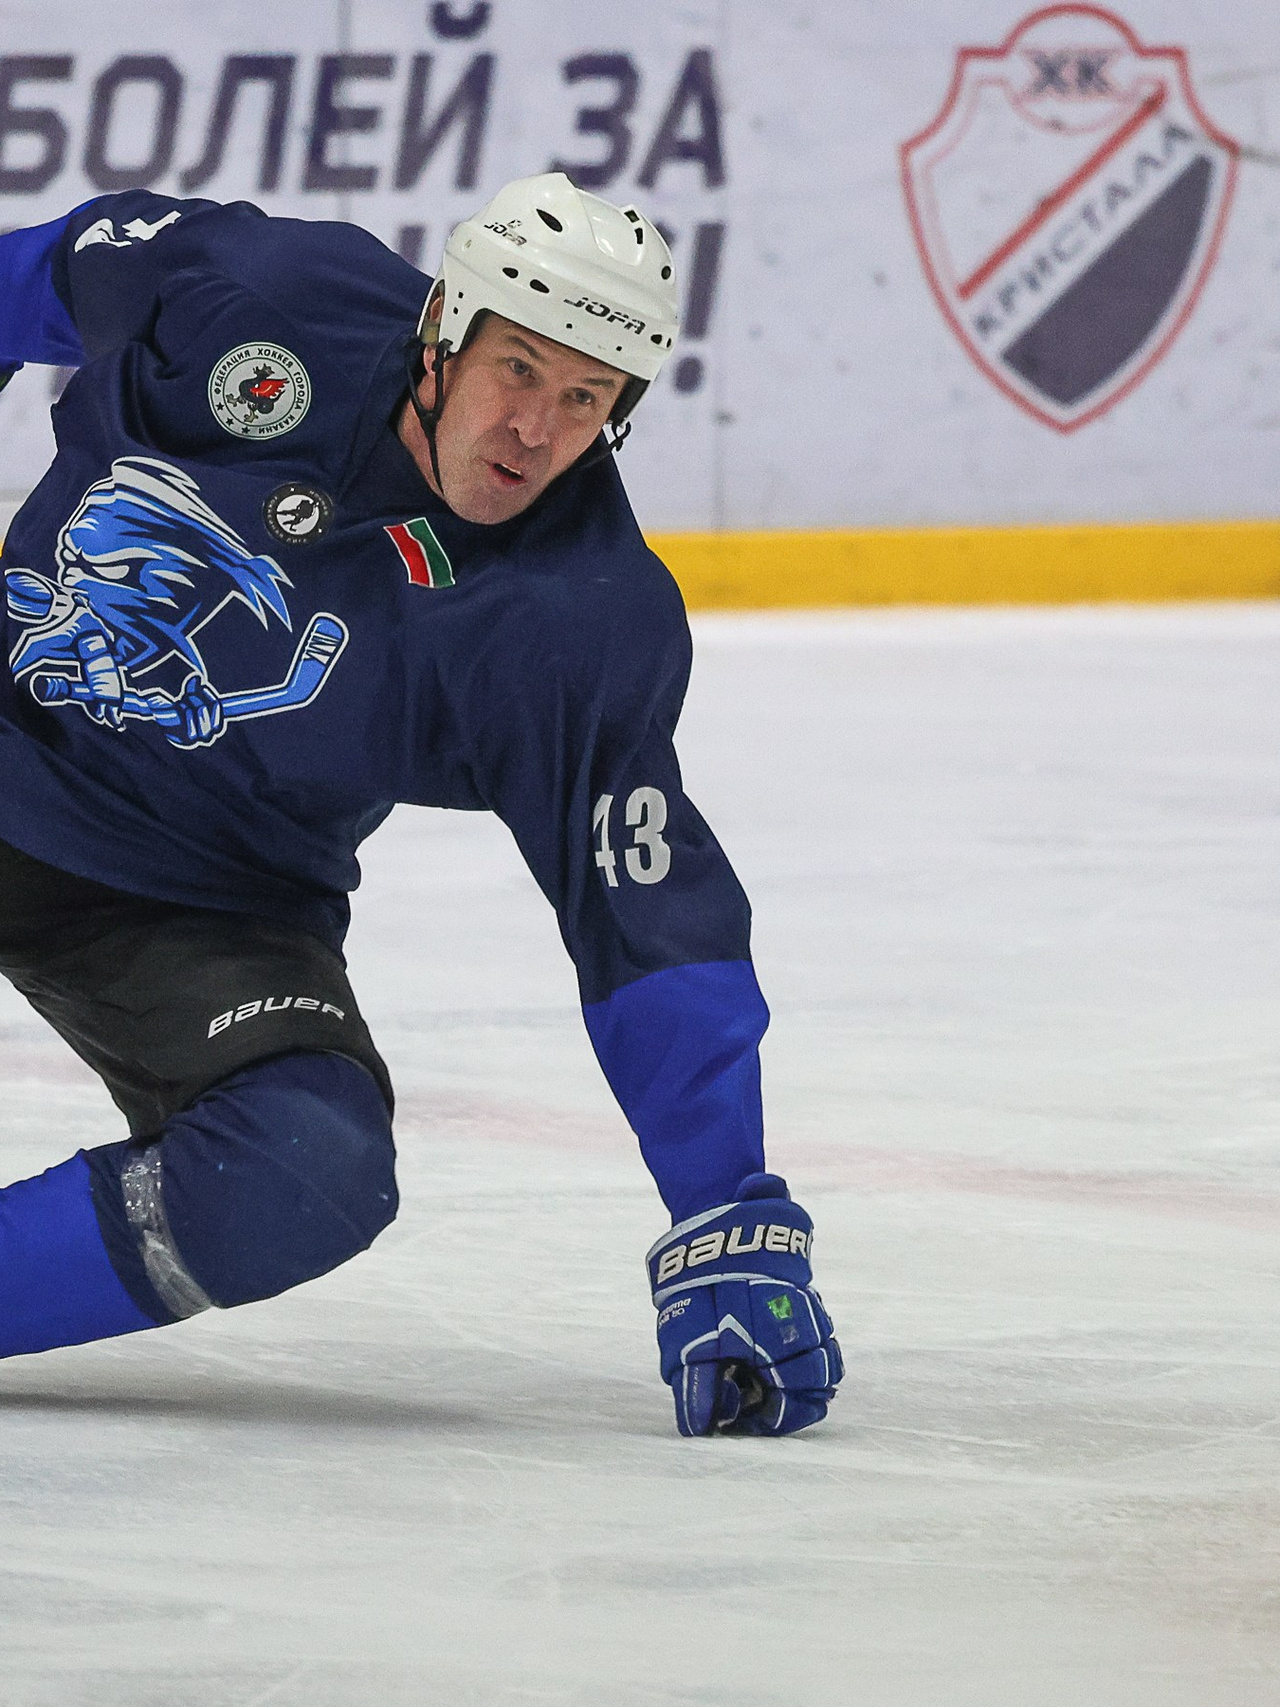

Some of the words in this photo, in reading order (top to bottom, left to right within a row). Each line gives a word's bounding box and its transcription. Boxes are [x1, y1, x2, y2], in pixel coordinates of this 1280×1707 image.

[1030, 52, 1113, 95] ХК
[548, 46, 728, 192] ЗА
[970, 121, 1196, 341] КРИСТАЛЛ
[562, 296, 647, 336] JOFA
[214, 349, 252, 396] ФЕДЕРАЦИЯ
[257, 347, 295, 369] ХОККЕЯ
[293, 371, 306, 410] ГОРОДА
[258, 414, 296, 435] КАЗАНИ
[207, 996, 346, 1039] BAUER
[656, 1223, 808, 1285] BAUER
